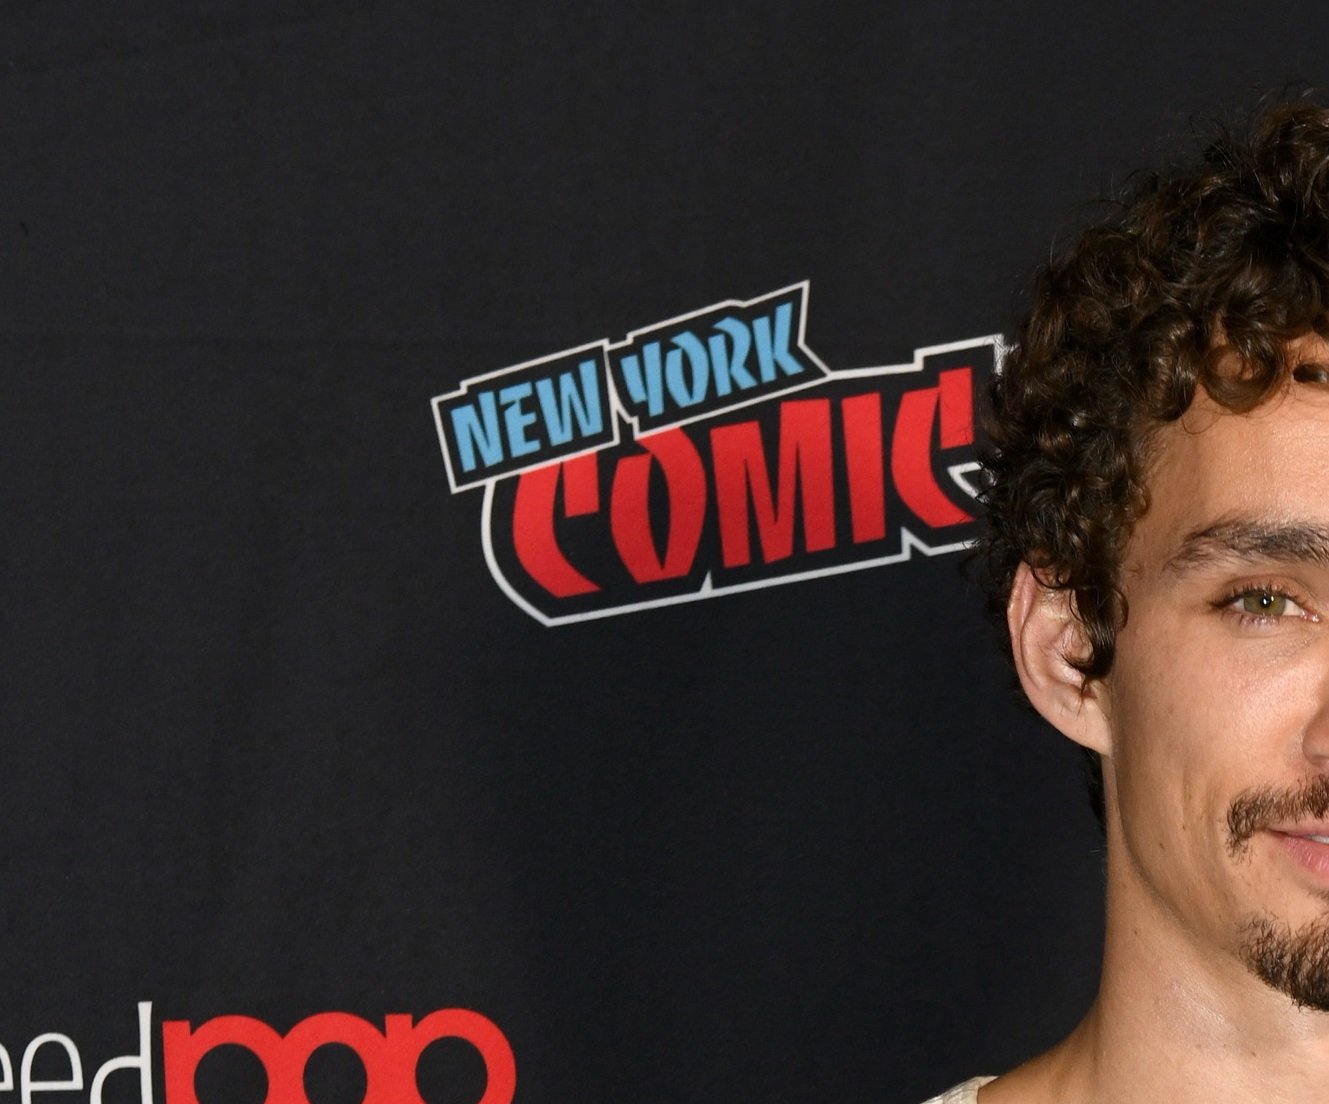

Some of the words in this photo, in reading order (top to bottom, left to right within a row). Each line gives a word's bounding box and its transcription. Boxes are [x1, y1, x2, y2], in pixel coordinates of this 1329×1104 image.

[449, 359, 603, 473] NEW
[619, 302, 804, 418] YORK
[512, 366, 976, 598] COMIC
